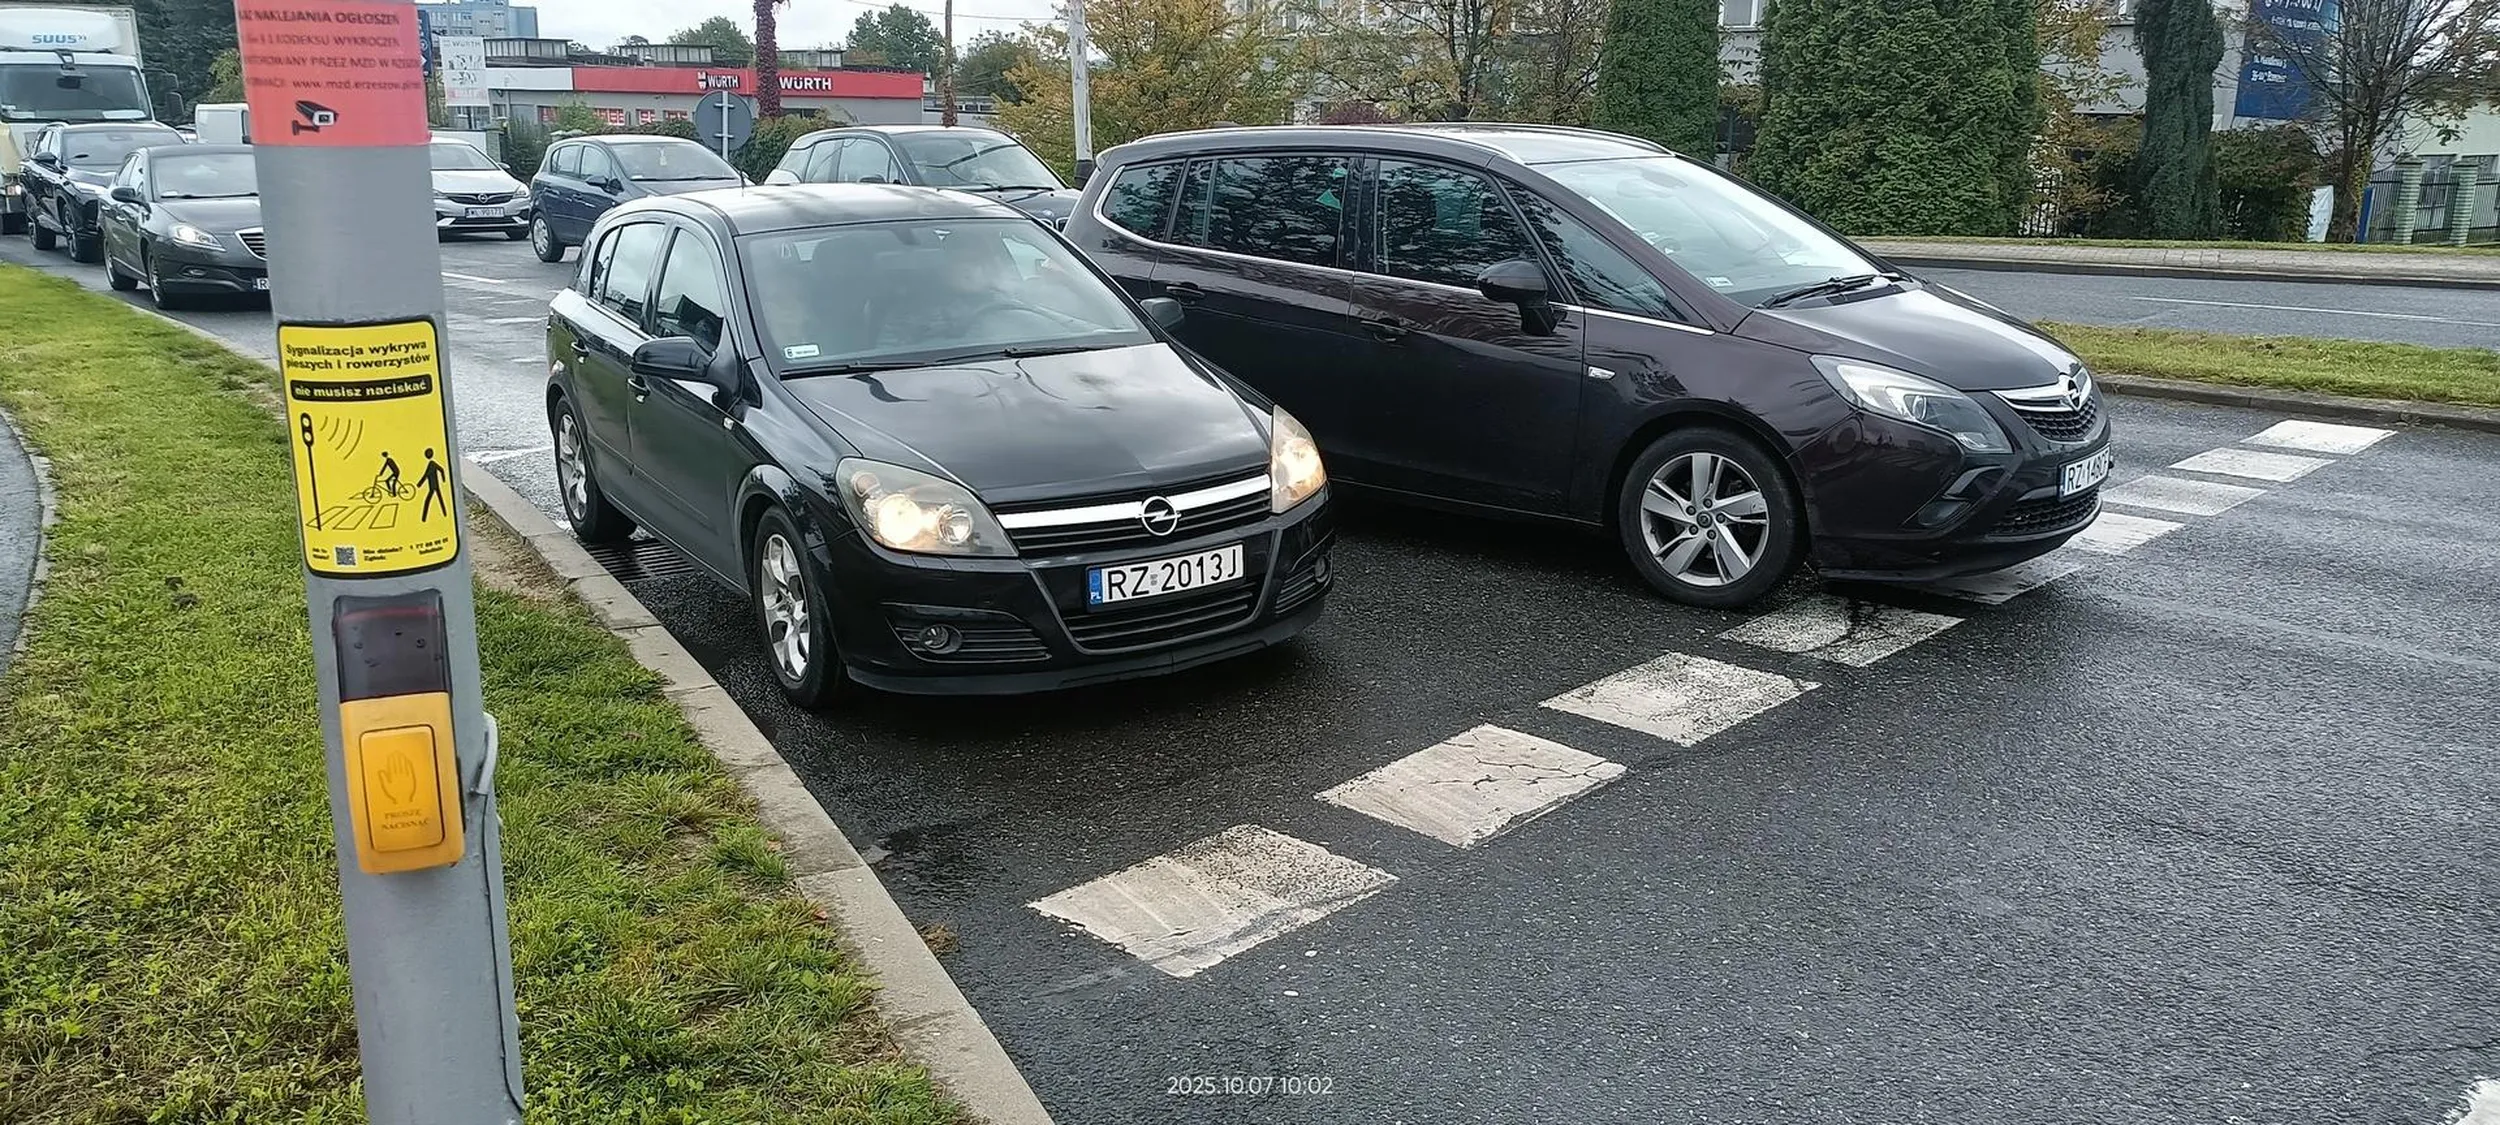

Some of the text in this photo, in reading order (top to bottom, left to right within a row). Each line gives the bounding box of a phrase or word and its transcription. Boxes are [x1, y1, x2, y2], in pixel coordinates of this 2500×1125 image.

[254, 11, 331, 23] NAKLEJANIA
[32, 34, 77, 44] SUUS
[707, 75, 739, 89] WÜRTH
[779, 76, 832, 90] WÜRTH
[286, 340, 427, 358] Sygnalizacja wykrywa
[286, 359, 333, 372] pieszych
[346, 353, 431, 369] rowerzystów
[294, 379, 427, 398] nie musisz naciskać
[1107, 548, 1237, 600] RZ 2013J
[1090, 591, 1102, 600] PL
